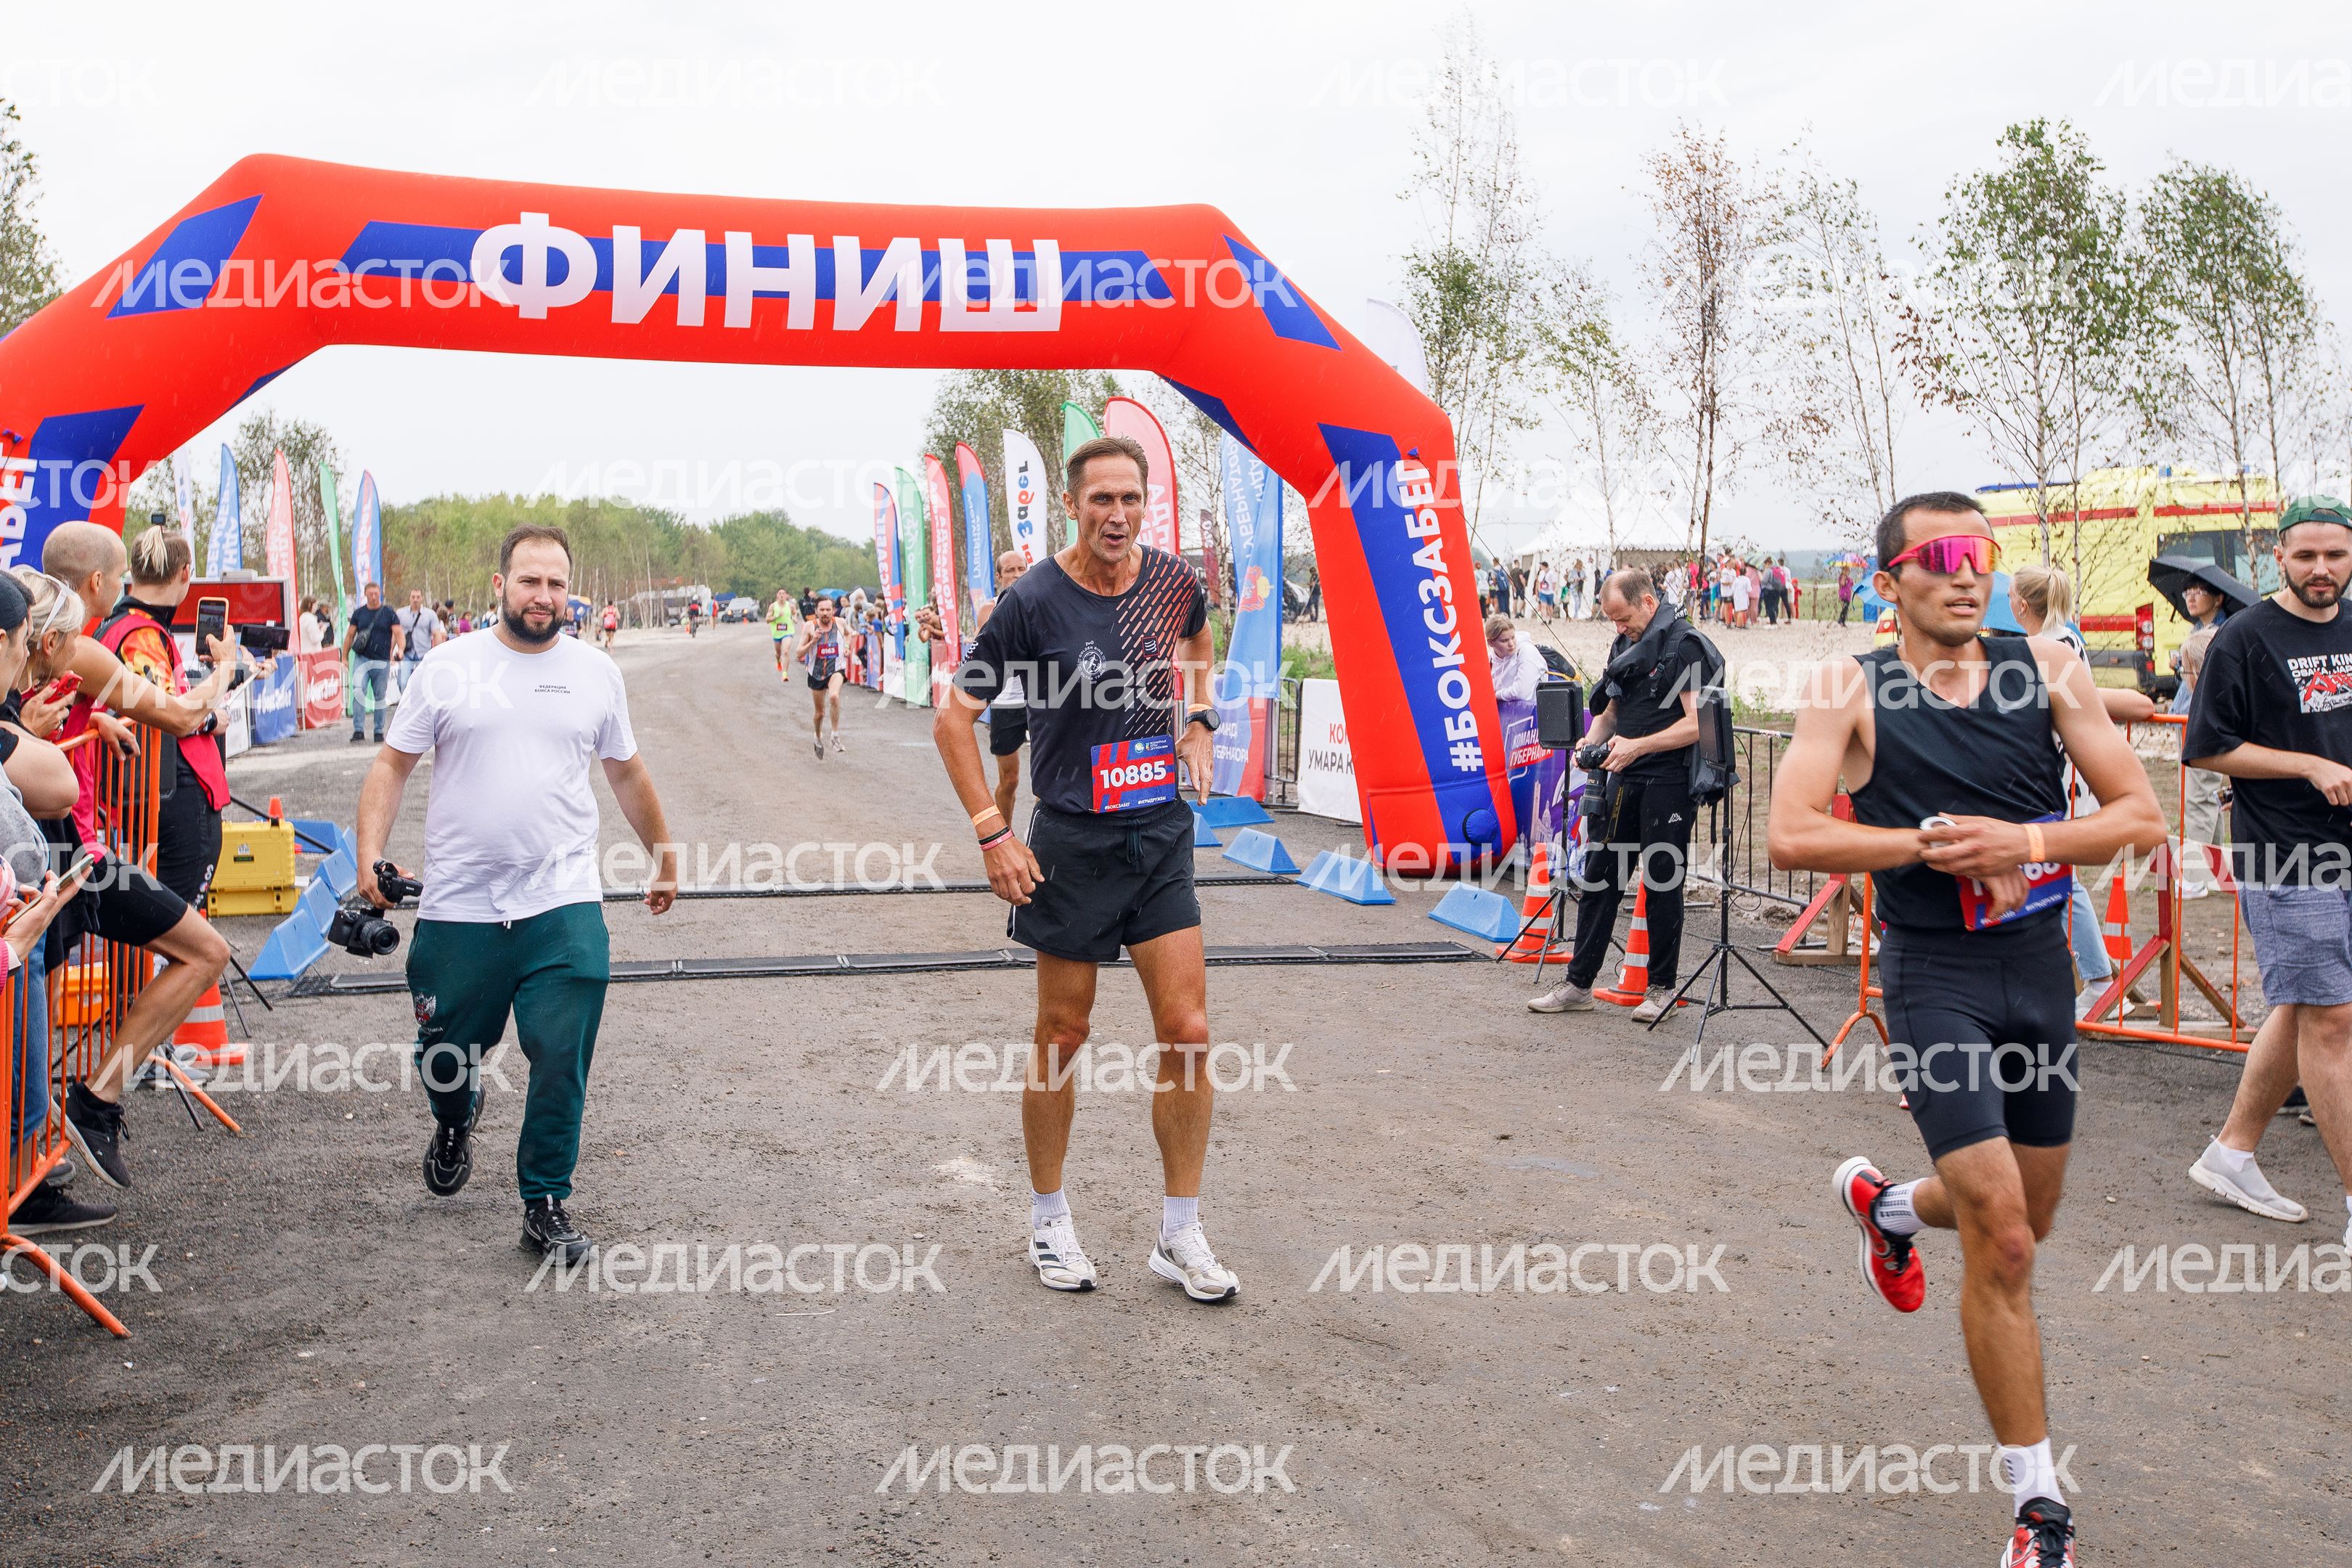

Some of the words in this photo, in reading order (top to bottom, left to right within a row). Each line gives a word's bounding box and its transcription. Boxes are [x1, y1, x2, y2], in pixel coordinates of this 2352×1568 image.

[470, 211, 1062, 333] ФИНИШ
[1395, 459, 1485, 773] #БОКСЗАБЕГ
[1078, 645, 1093, 658] GOLDEN
[2287, 655, 2327, 671] DRIFT
[1308, 749, 1344, 772] УМАРА
[1100, 760, 1167, 789] 10885
[1104, 801, 1130, 810] #БОКСЗАБЕГ
